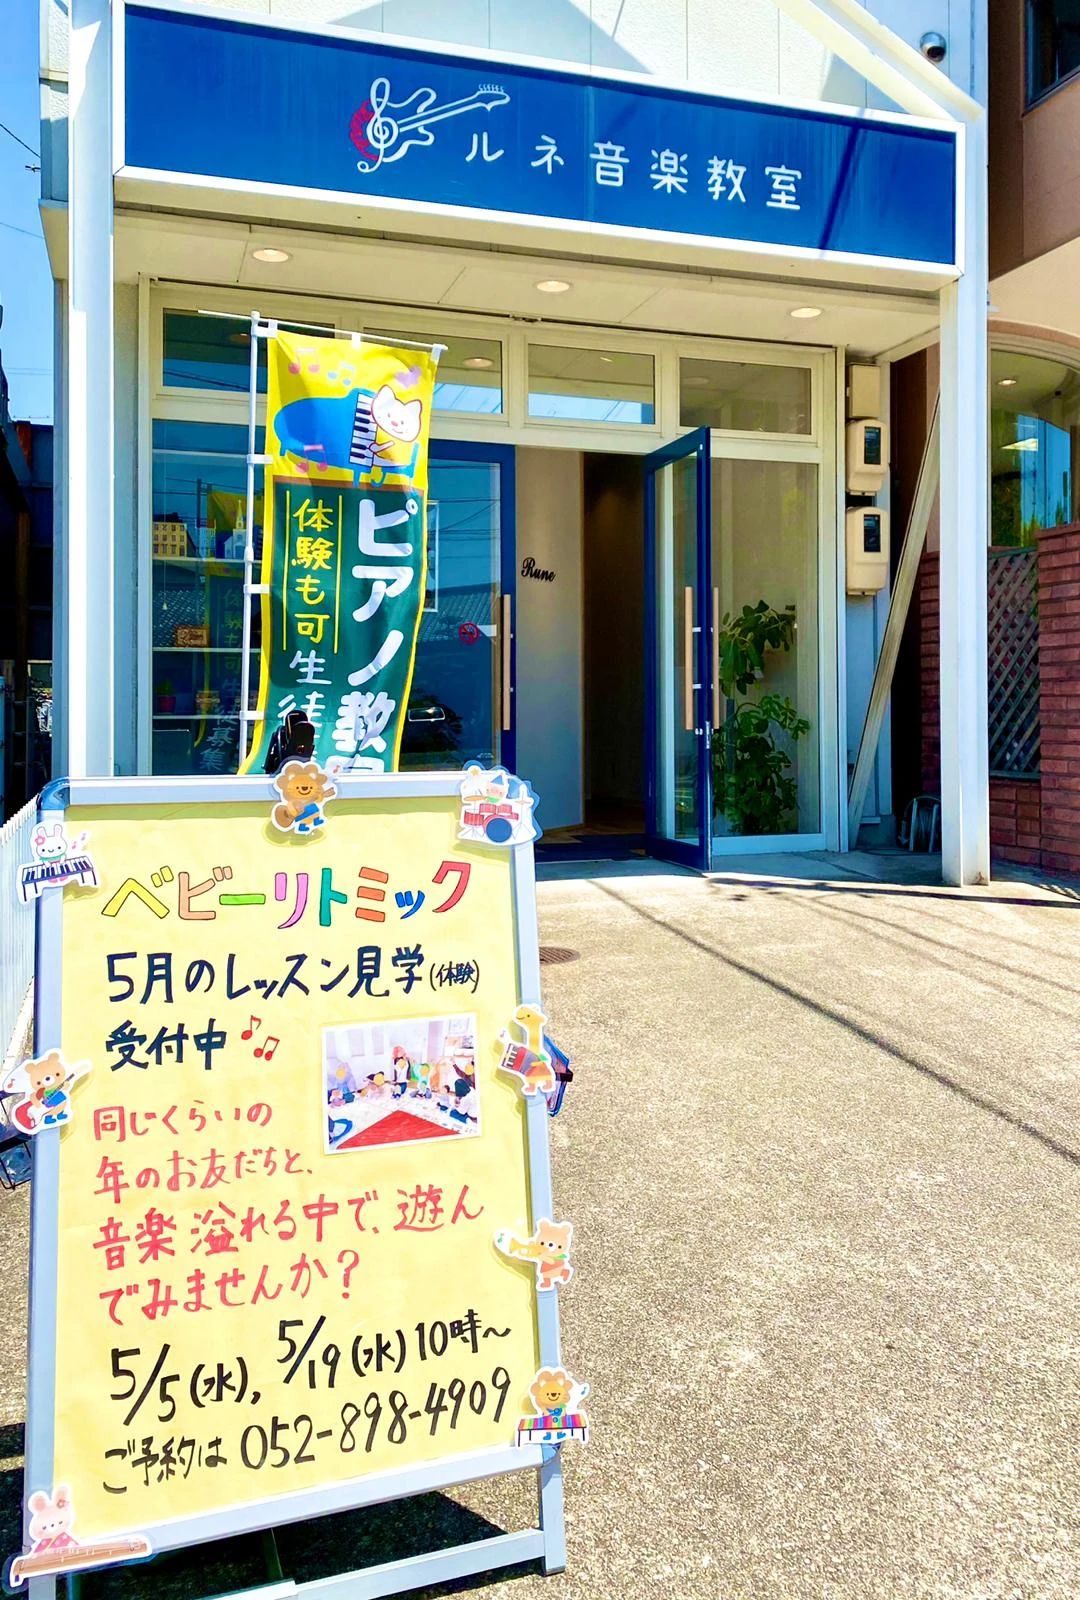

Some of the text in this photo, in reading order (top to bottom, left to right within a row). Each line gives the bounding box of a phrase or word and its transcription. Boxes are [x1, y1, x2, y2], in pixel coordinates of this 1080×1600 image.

[465, 132, 800, 211] ルネ音楽教室
[521, 556, 556, 582] Rune
[101, 861, 471, 929] ベビーリトミック
[105, 1019, 226, 1071] 受付中
[94, 1100, 271, 1142] 同じくらいの
[94, 1146, 313, 1203] 年のお友だちと、
[241, 1366, 511, 1471] 052-898-4909
